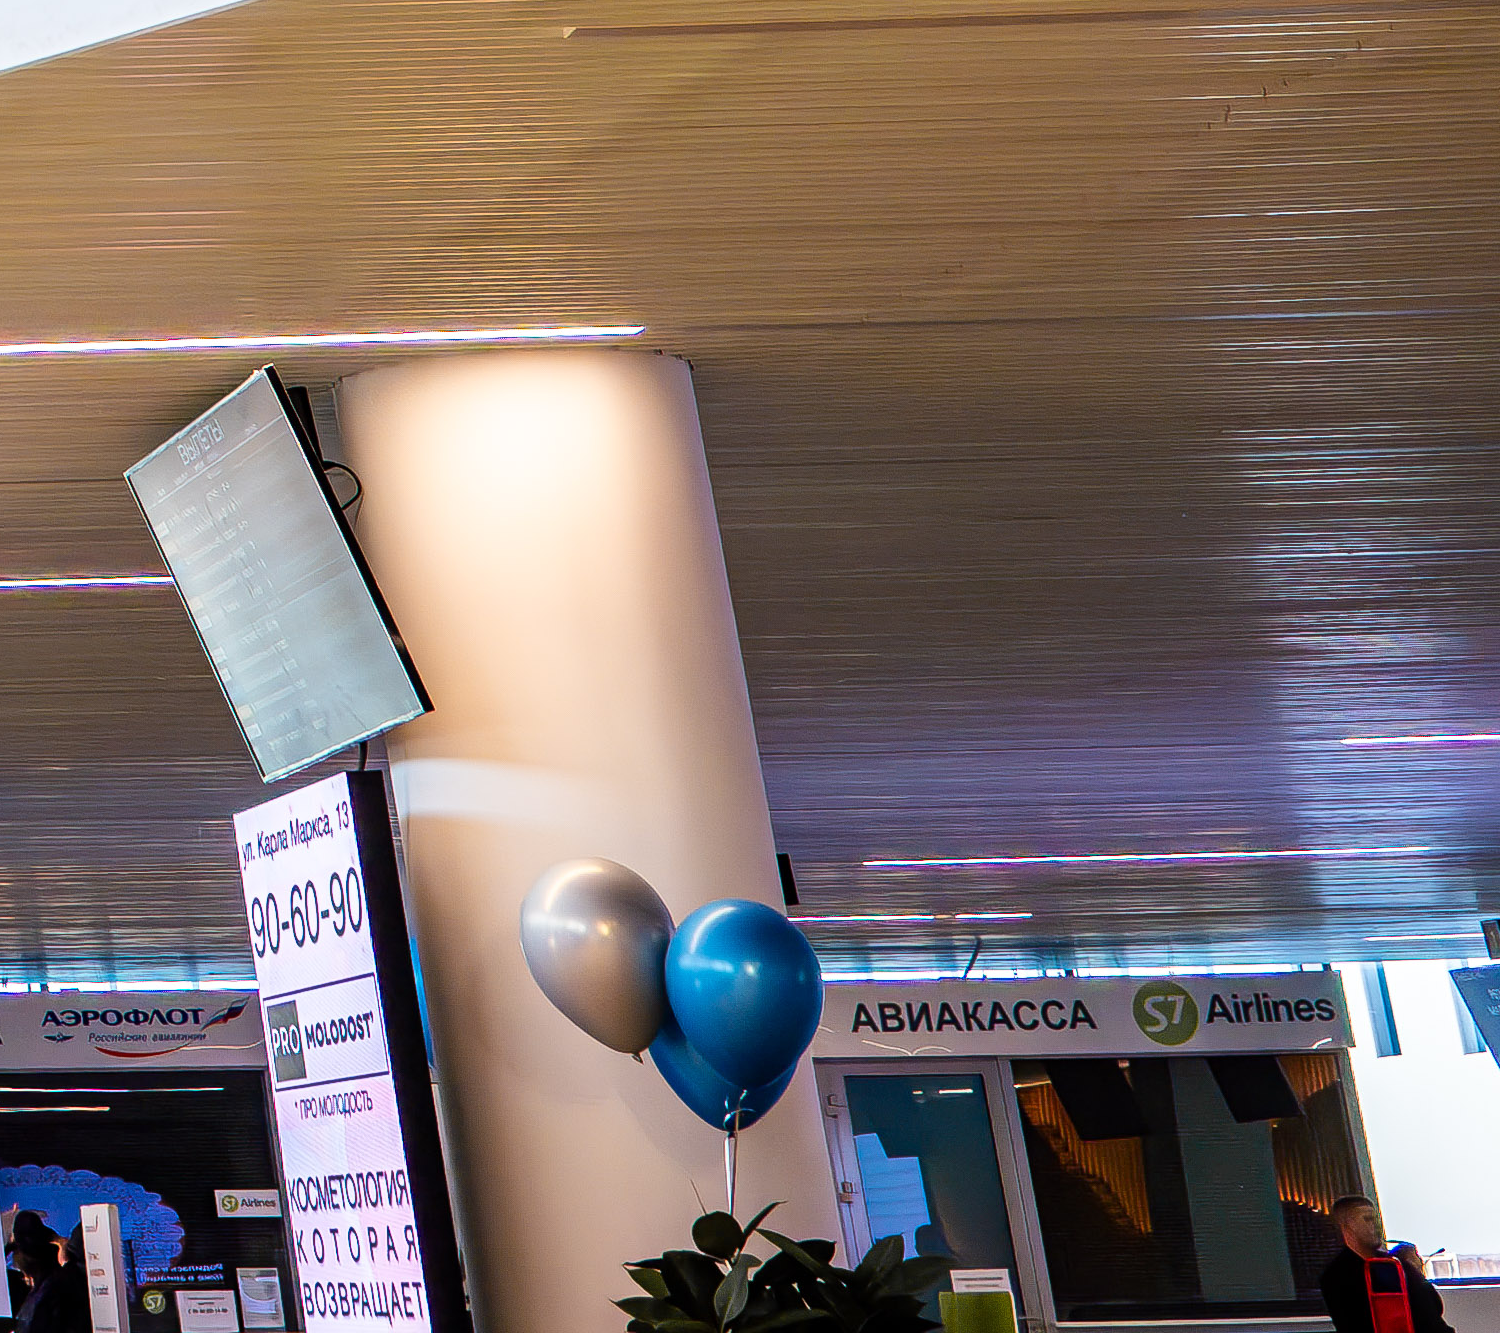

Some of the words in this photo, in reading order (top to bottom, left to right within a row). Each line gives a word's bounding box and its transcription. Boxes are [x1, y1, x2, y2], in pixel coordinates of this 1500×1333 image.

[176, 418, 226, 466] ВЫЛЕТЫ
[241, 841, 256, 870] ул.
[257, 829, 289, 861] Карла
[289, 812, 334, 848] Маркса,
[335, 801, 349, 831] 13
[252, 867, 363, 958] 90-60-90
[41, 1007, 205, 1027] АЭРОФЛОТ
[851, 998, 1098, 1033] АВИАКАССА
[1206, 992, 1336, 1024] Airlines
[88, 1032, 147, 1043] Российские
[152, 1033, 207, 1042] авиалинии
[271, 1024, 301, 1058] PRO
[300, 1098, 318, 1120] ПРО
[319, 1090, 373, 1118] МОЛОДОСТЬ
[240, 1197, 276, 1208] Airlines
[288, 1169, 410, 1212] КОСМЕТОЛОГИЯ
[295, 1224, 419, 1265] КОТОРАЯ
[303, 1281, 425, 1327] ВОЗВРАЩАЕТ
